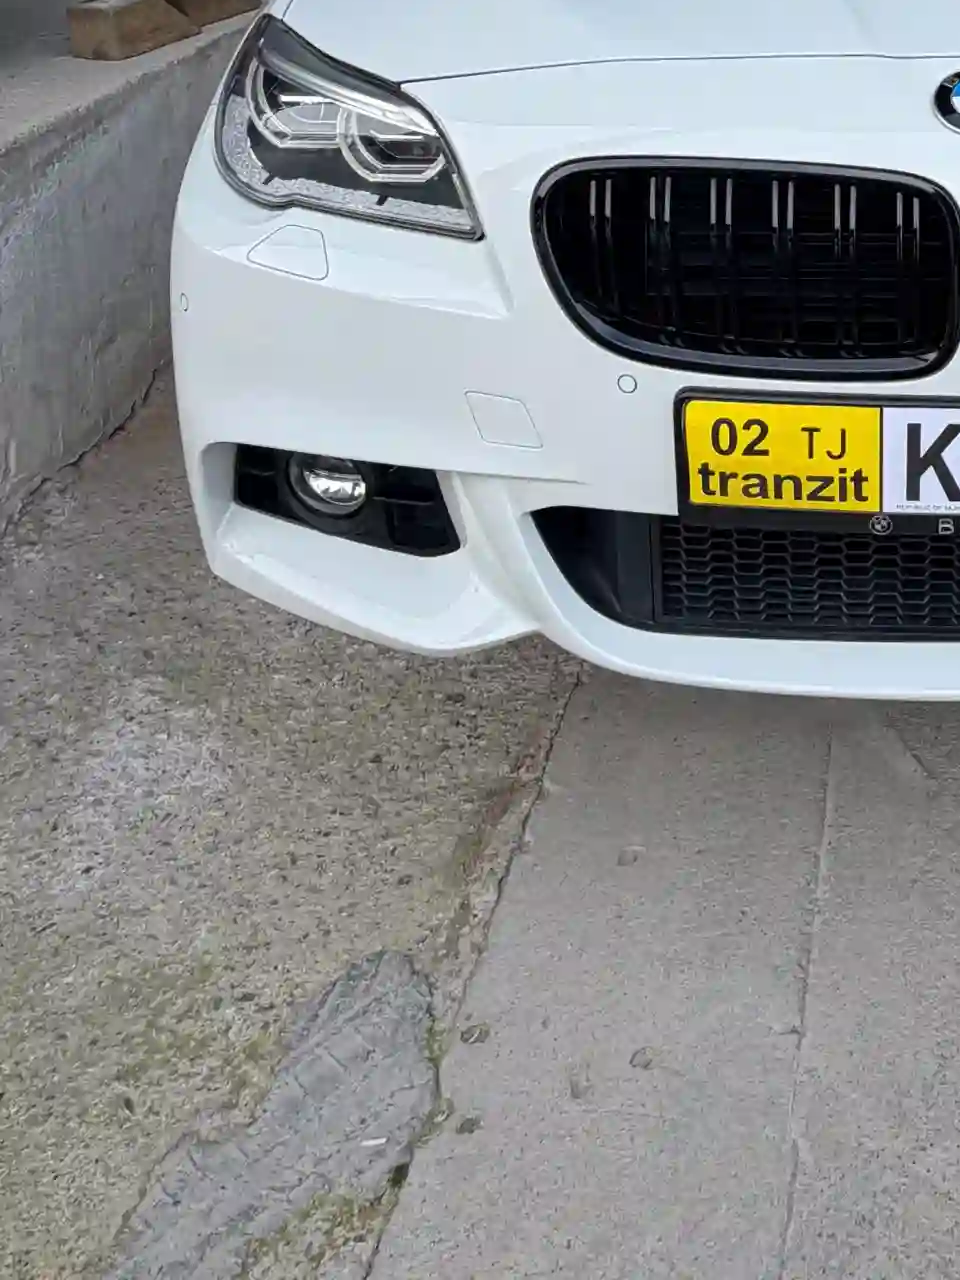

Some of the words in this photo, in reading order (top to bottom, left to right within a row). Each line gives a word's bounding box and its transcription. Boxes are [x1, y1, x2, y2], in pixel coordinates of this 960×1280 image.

[711, 417, 770, 457] 02
[800, 426, 846, 460] TJ
[698, 461, 869, 503] tranzit
